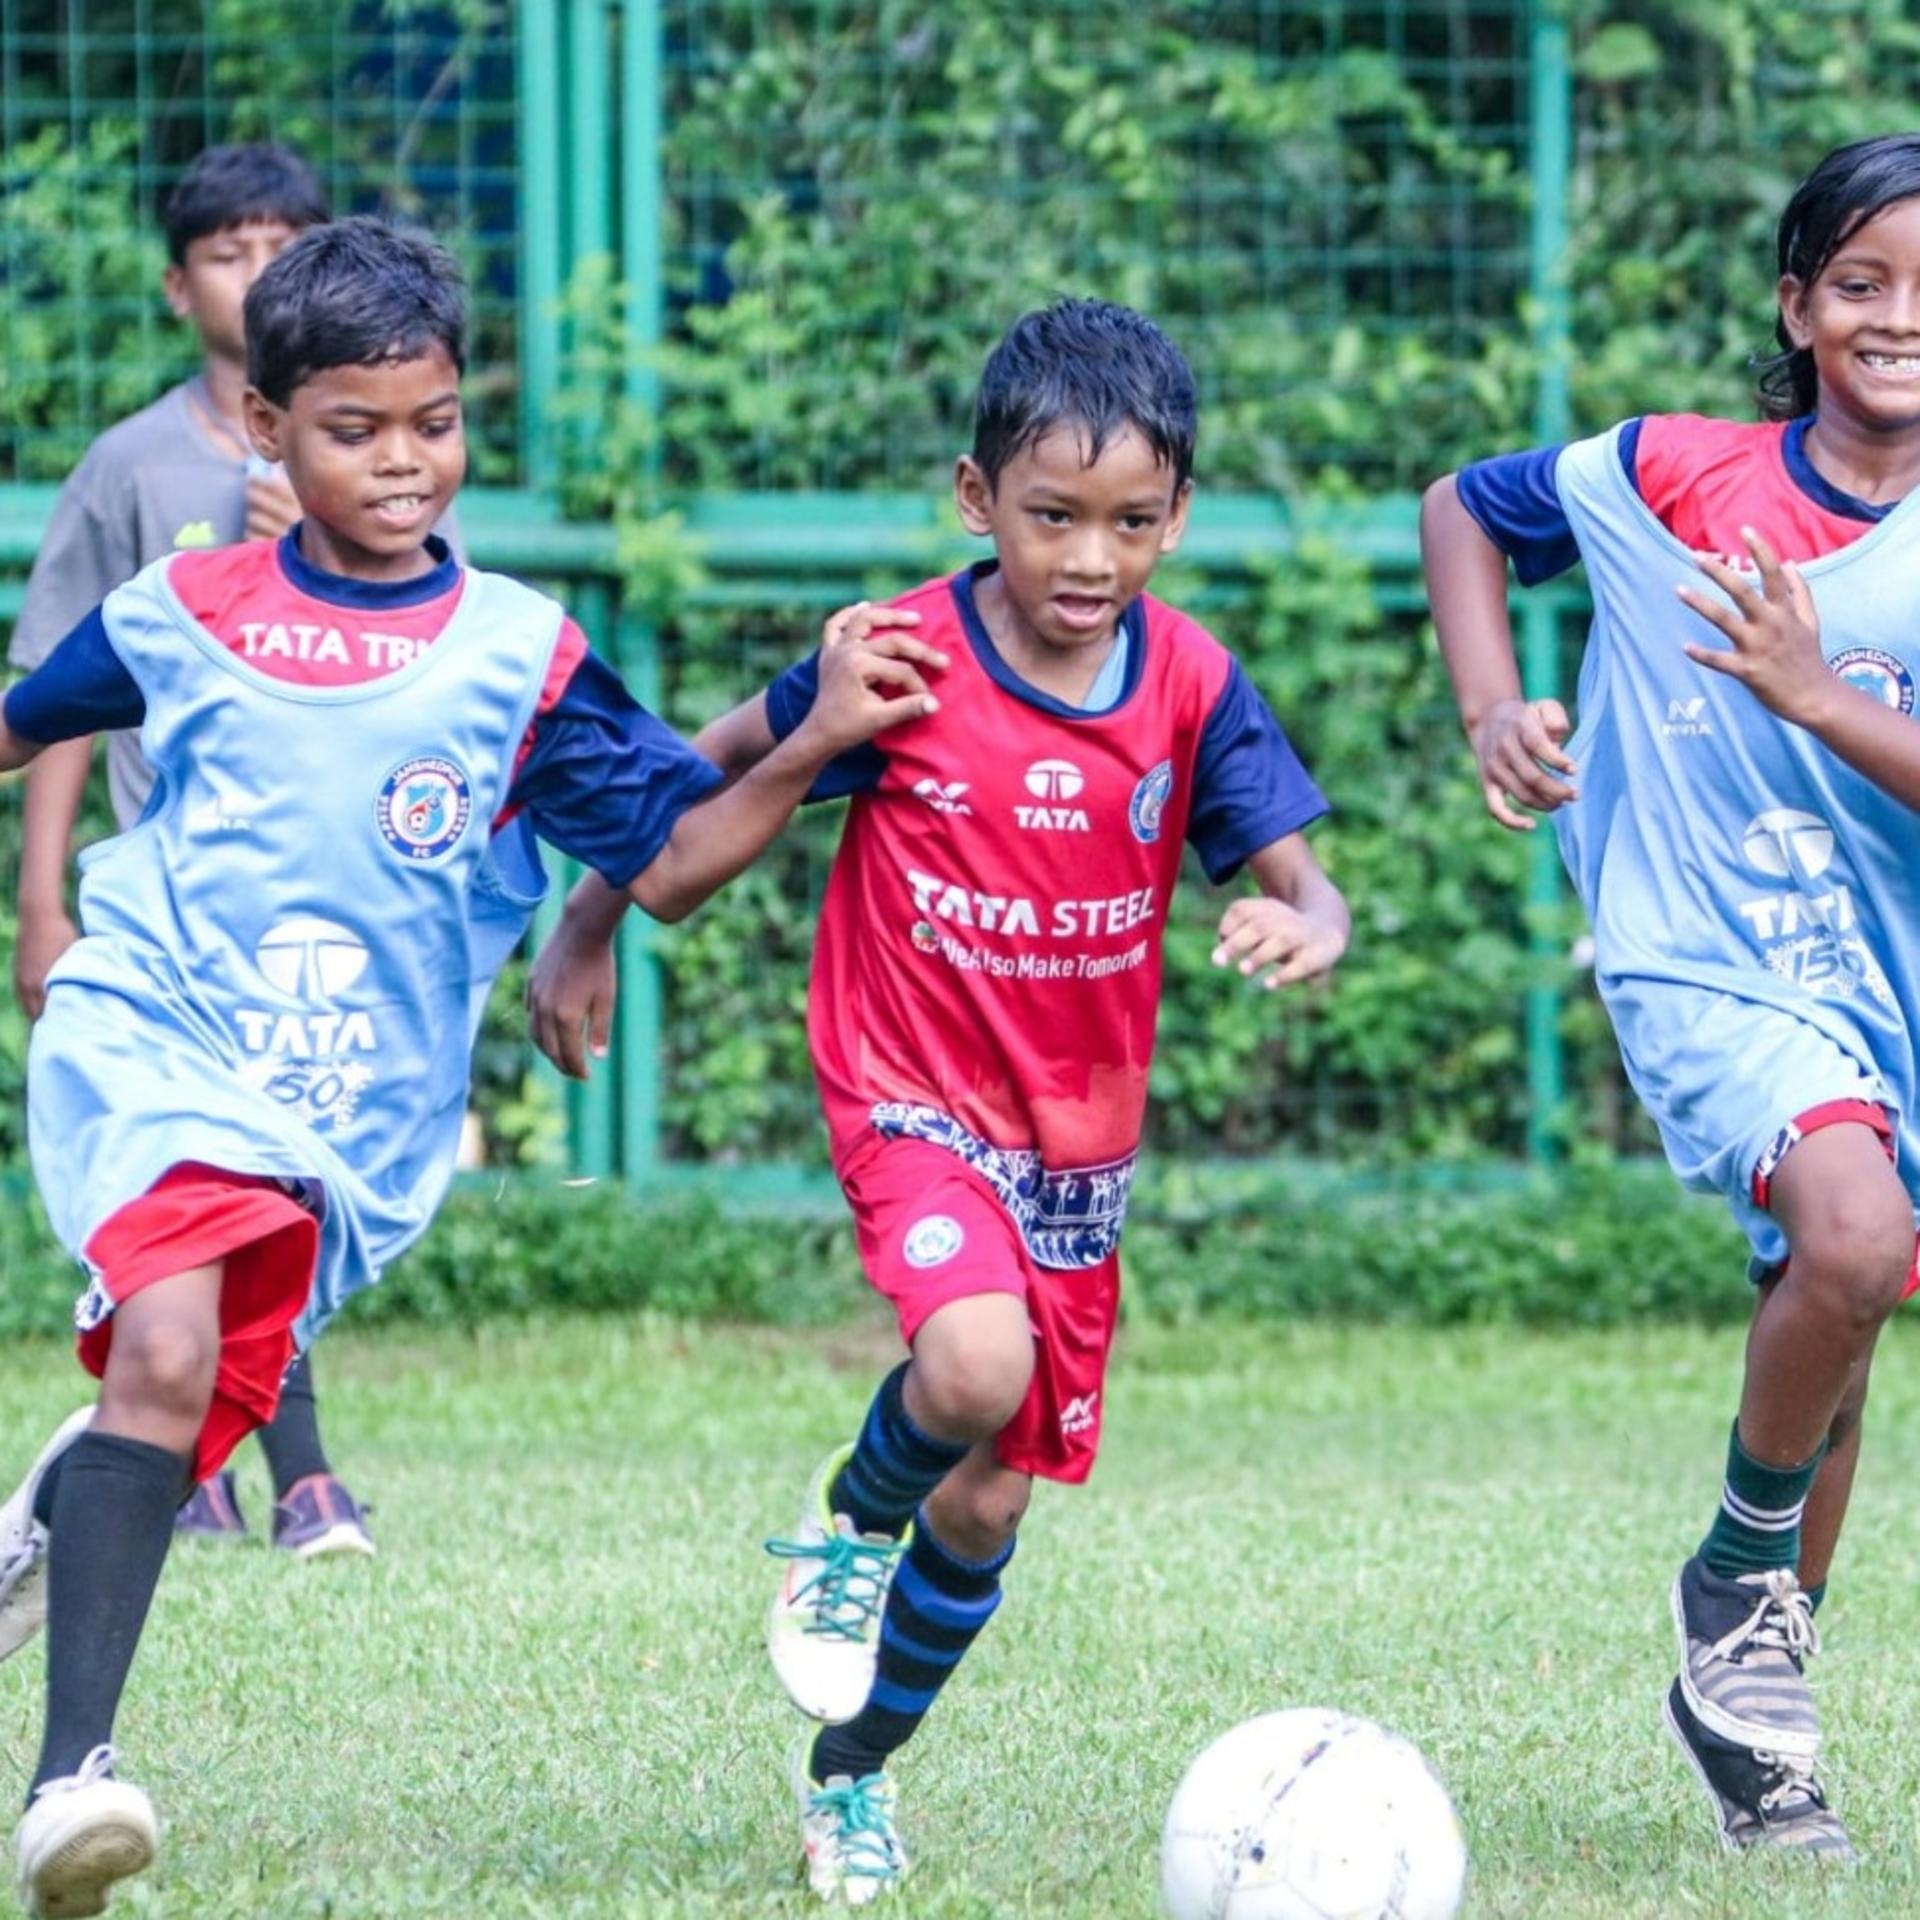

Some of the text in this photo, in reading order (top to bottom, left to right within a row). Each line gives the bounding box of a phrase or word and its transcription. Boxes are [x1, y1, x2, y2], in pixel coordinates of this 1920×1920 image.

[239, 622, 350, 665] TATA
[1013, 806, 1090, 832] TATA
[906, 869, 1155, 938] TATA STEEL
[1016, 953, 1074, 979] Make
[233, 1008, 378, 1058] TATA
